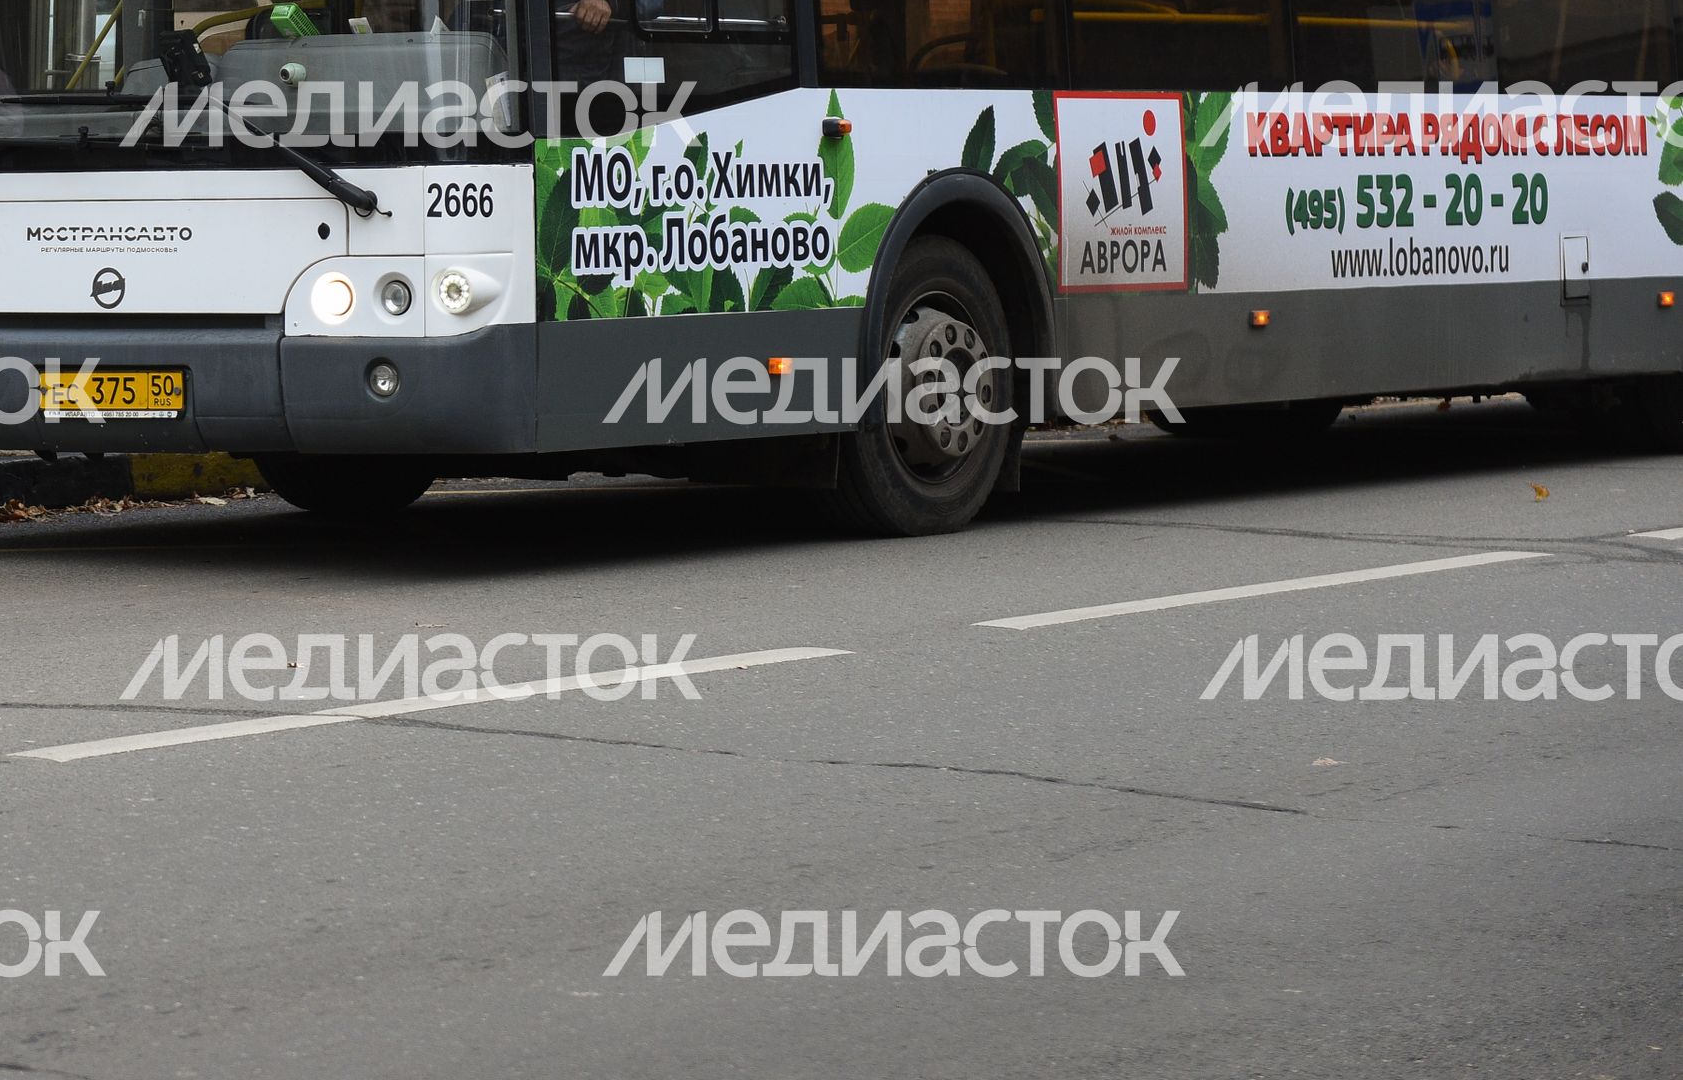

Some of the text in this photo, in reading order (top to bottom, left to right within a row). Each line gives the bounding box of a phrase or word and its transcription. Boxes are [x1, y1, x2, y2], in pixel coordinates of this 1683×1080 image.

[1246, 111, 1416, 157] КВАРТИРА
[1422, 113, 1528, 164] РЯДОМ
[1553, 115, 1648, 156] ЛЕСОМ
[575, 151, 831, 208] МО, г.о. Химки,
[426, 182, 494, 219] 2666
[1285, 187, 1346, 235] (495)
[27, 226, 193, 242] МОСТРАНСАВТО
[575, 213, 831, 281] мкр. Лобаново
[1080, 239, 1167, 274] АВРОРА
[1331, 237, 1510, 278] www.lobanovo.ru
[91, 377, 136, 405] 375
[151, 375, 174, 397] 50
[154, 398, 171, 406] RUS
